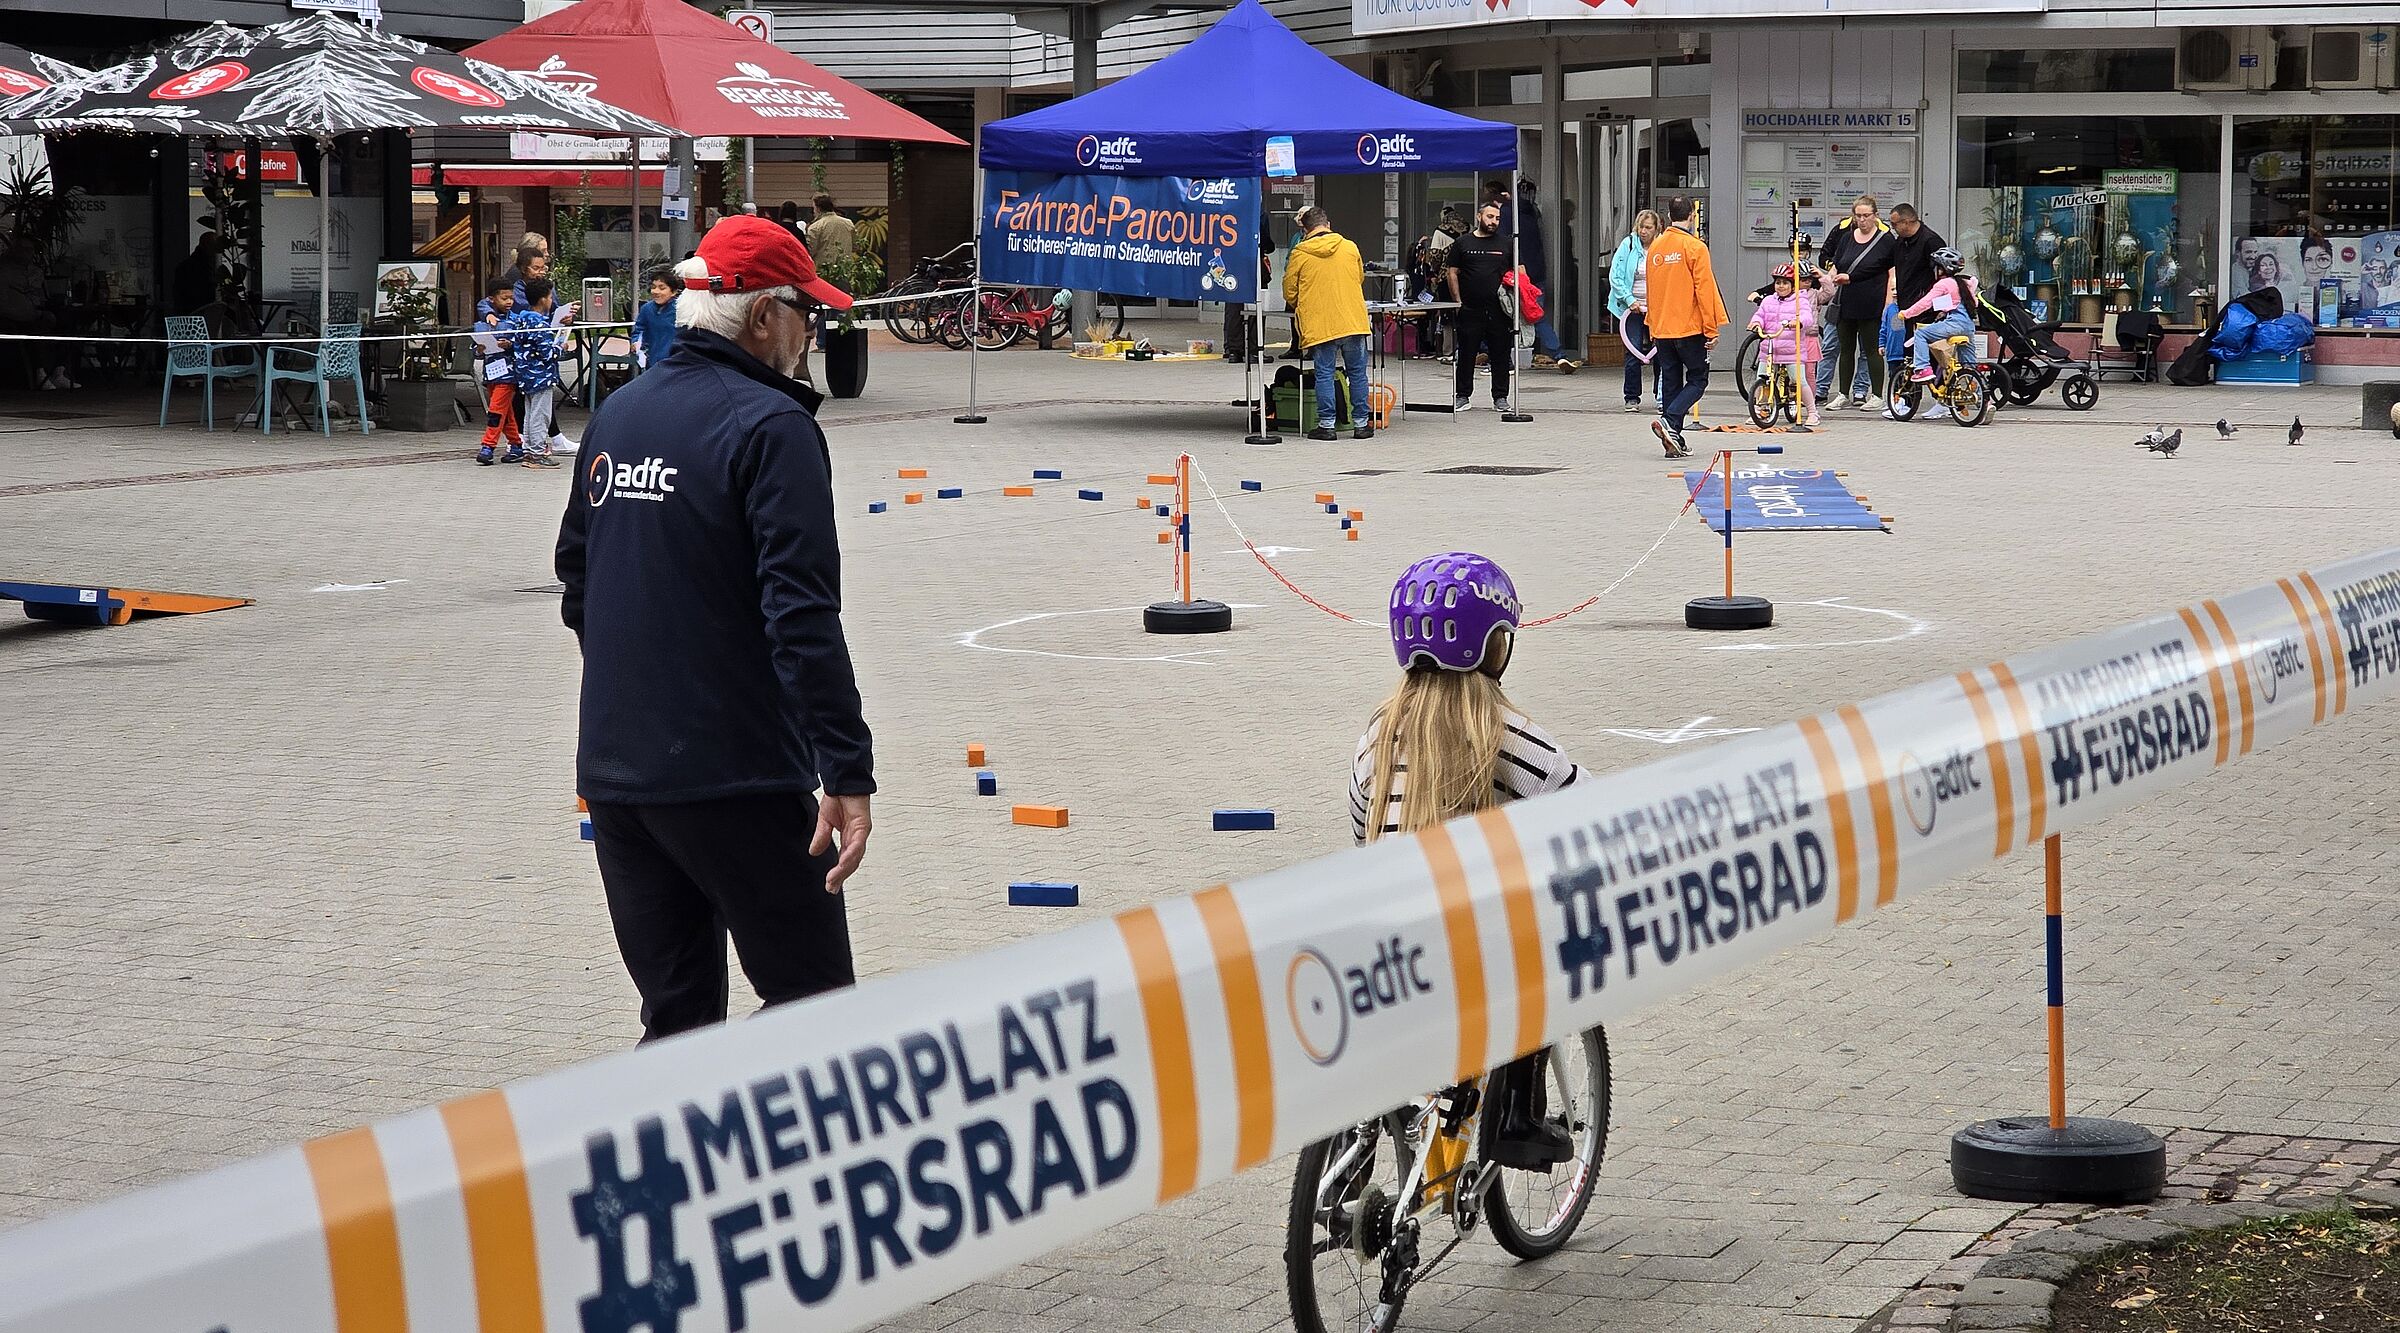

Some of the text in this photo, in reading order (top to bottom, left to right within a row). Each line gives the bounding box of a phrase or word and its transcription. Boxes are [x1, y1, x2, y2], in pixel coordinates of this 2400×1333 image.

[716, 86, 845, 107] BERGISCHE
[750, 106, 851, 120] WALDQUELLE
[1745, 113, 1912, 126] HOCHDAHLER MARKT 15
[547, 139, 564, 149] Obst
[573, 139, 599, 149] Gemüse
[601, 139, 625, 151] täglich
[652, 139, 669, 149] Liefe
[1100, 136, 1137, 156] adfc
[1380, 133, 1415, 153] adfc
[260, 158, 287, 171] dafone
[1205, 178, 1236, 194] adfc
[2106, 173, 2163, 185] Insektenstiche
[72, 200, 106, 212] OCESS
[2052, 192, 2107, 208] Mücken
[994, 190, 1239, 247] Fahrrad-Parcours
[1007, 233, 1022, 252] für
[1103, 240, 1116, 259] im
[1118, 241, 1203, 267] Straßenverkehr
[614, 457, 678, 493] adfc
[1468, 580, 1519, 620] woom
[2270, 637, 2305, 678] adfc
[2082, 690, 2212, 793] FÜRSRAD
[1930, 750, 1982, 802] adfc
[1614, 829, 1829, 980] FÜRSRAD
[1345, 935, 1434, 1016] adfc
[709, 1076, 1141, 1333] FÜRSRAD
